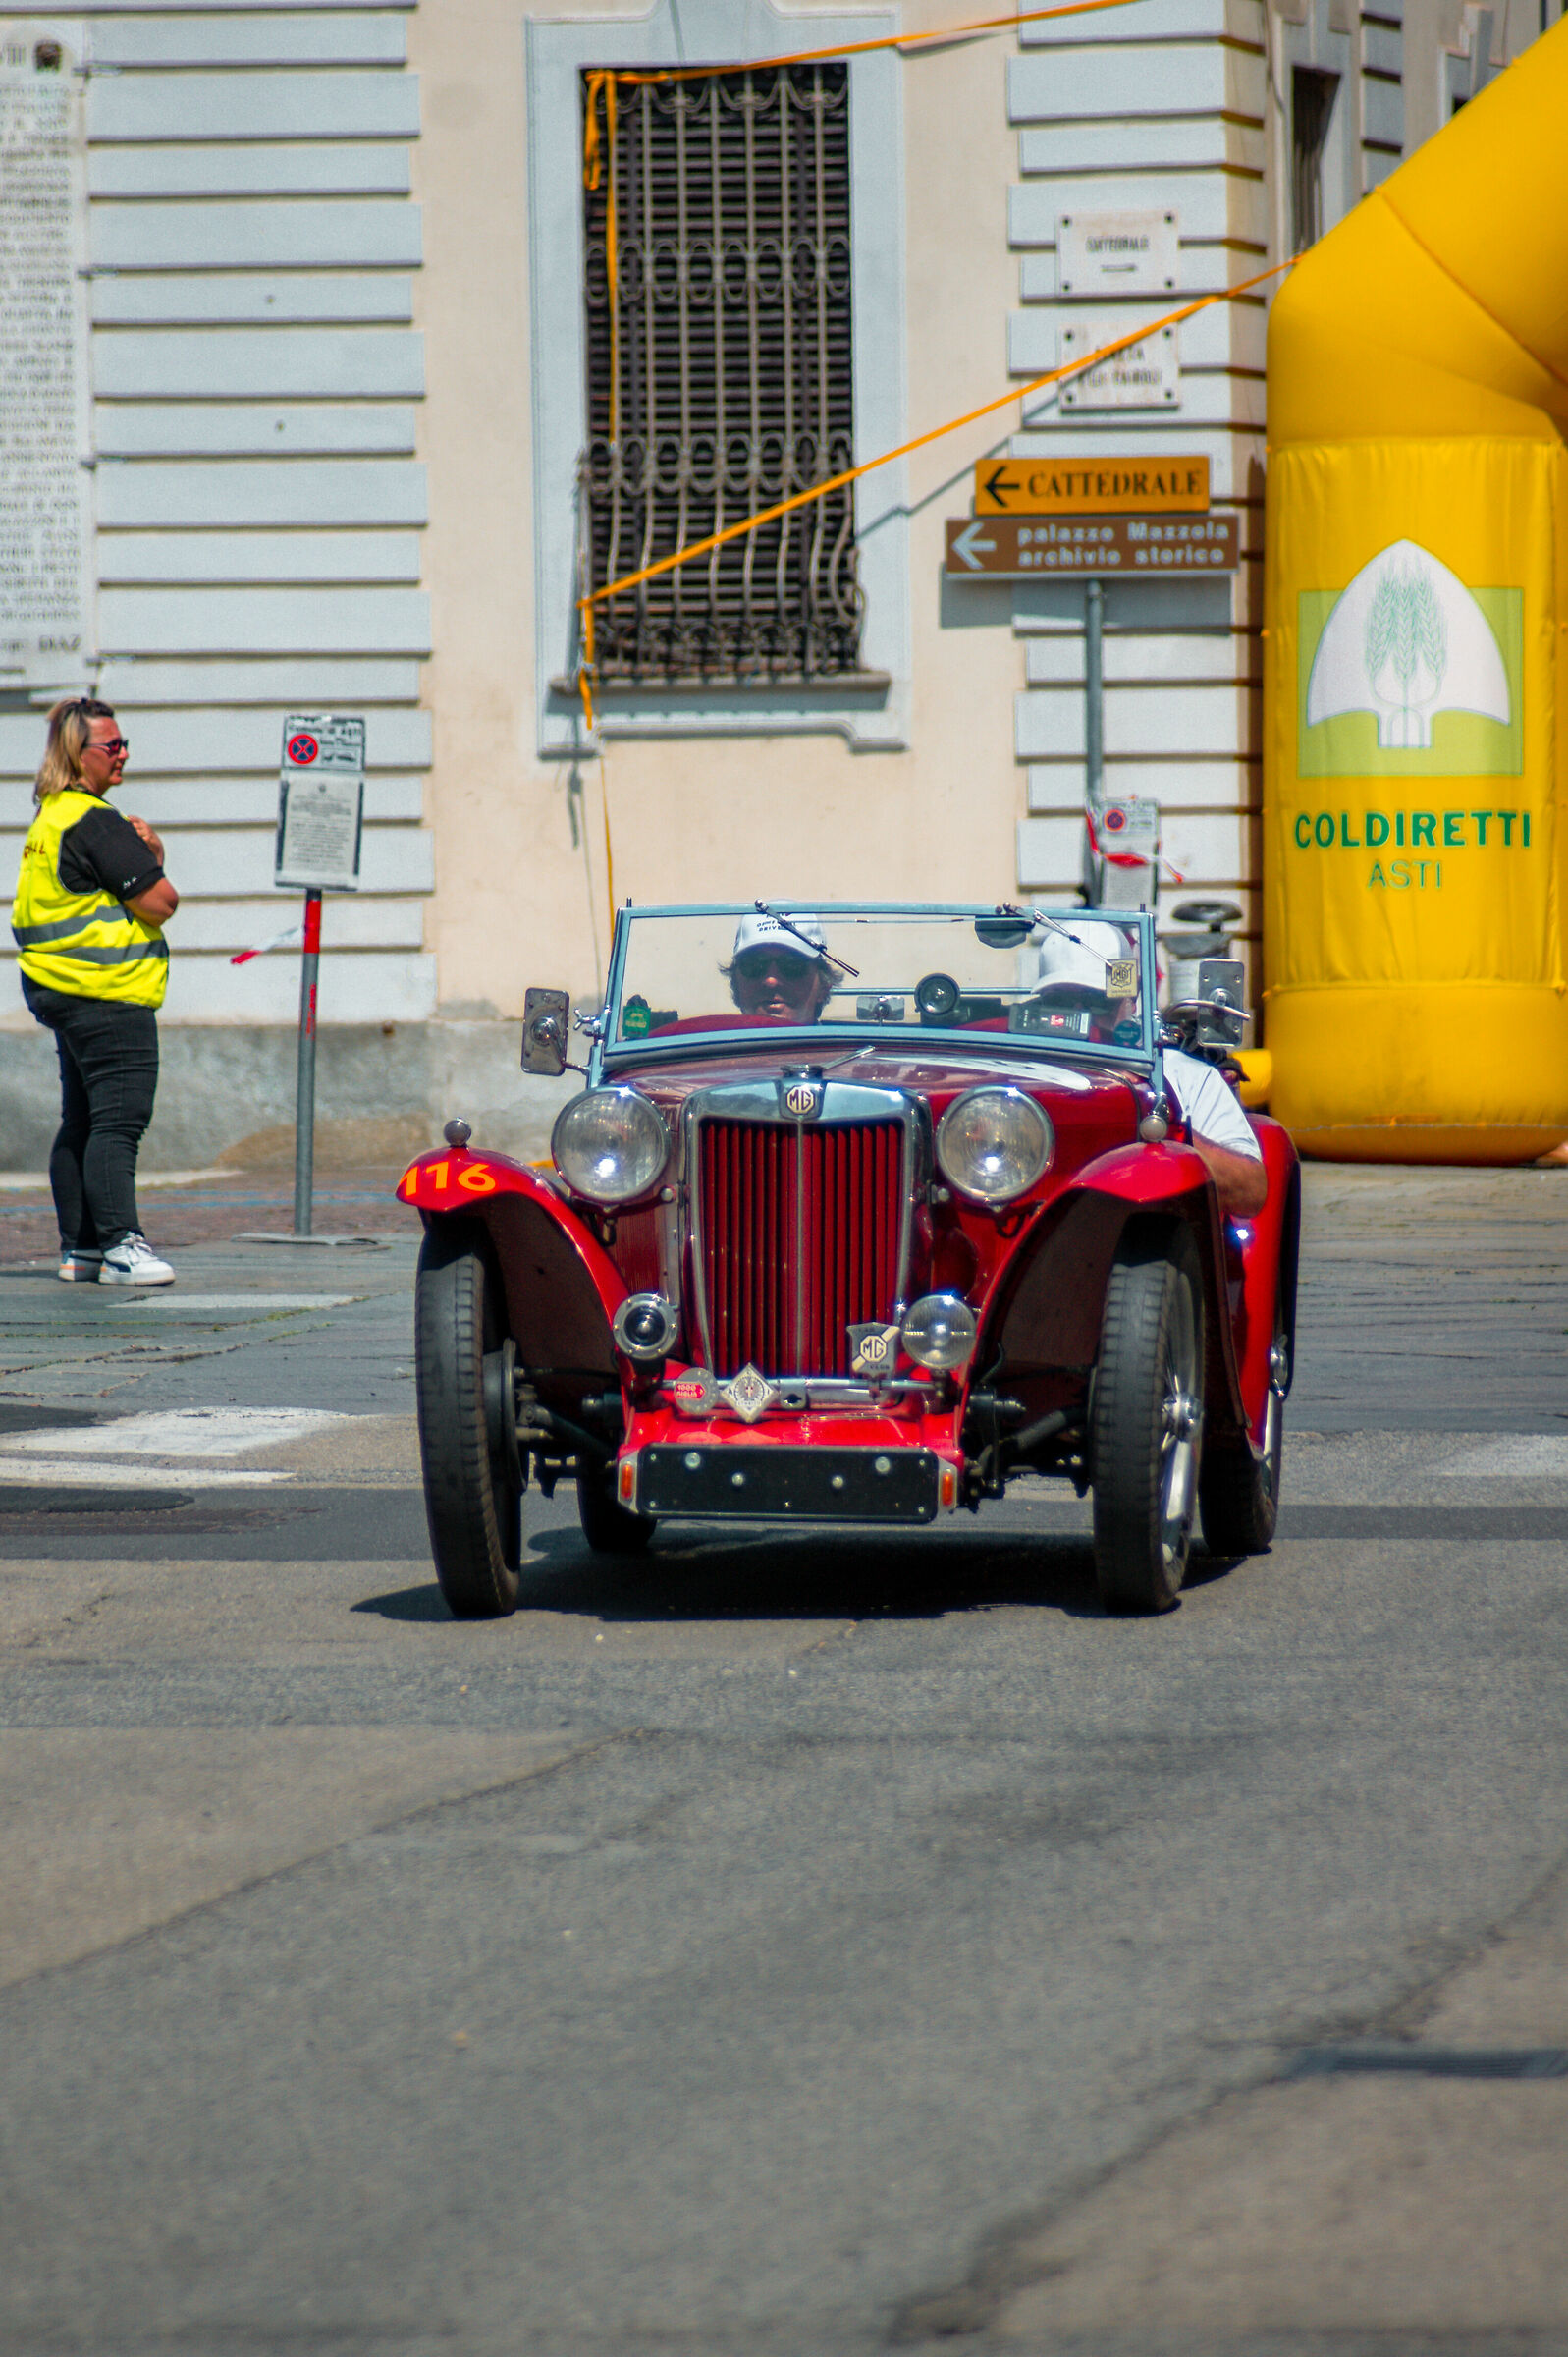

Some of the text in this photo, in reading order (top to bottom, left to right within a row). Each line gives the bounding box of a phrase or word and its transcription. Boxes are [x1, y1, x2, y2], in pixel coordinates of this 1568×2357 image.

[1029, 470, 1202, 498] CATTEDRALE
[1018, 521, 1228, 546] palazzo Mazzola
[1018, 544, 1224, 566] archivio storico
[1295, 811, 1530, 849] COLDIRETTI
[1368, 860, 1441, 889] ASTI
[789, 1089, 812, 1111] MG
[399, 1162, 496, 1196] 116
[863, 1338, 884, 1359] MG
